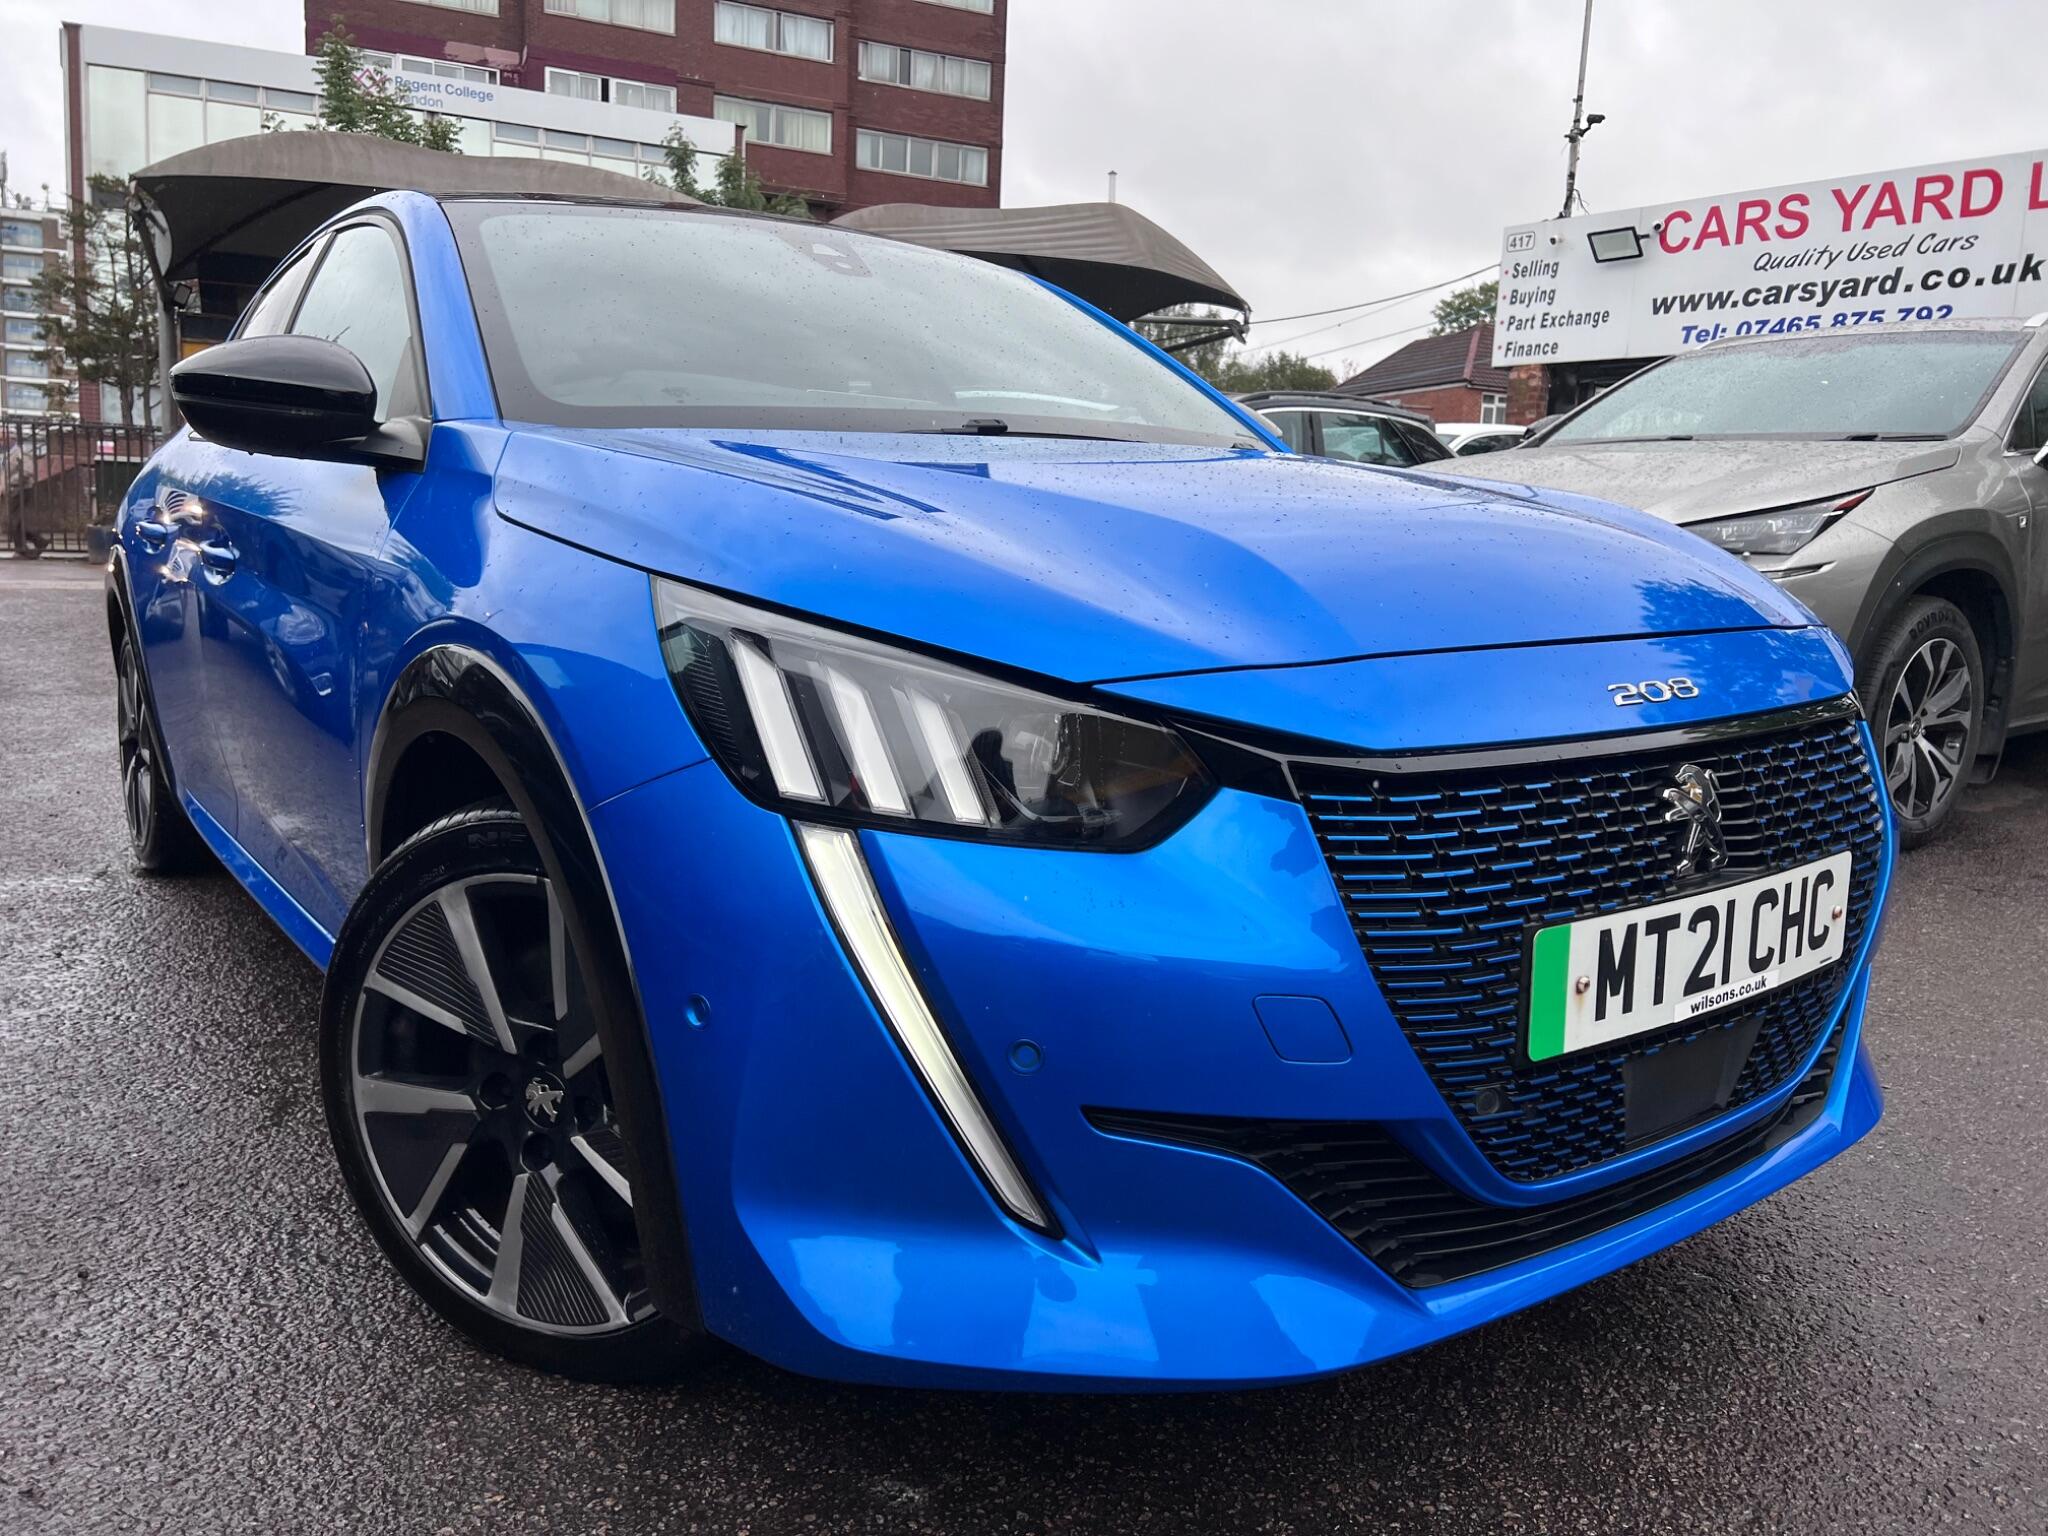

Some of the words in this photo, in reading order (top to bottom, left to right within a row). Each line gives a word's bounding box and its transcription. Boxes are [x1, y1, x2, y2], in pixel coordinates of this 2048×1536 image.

[394, 75, 441, 93] Regent
[445, 83, 494, 103] College
[395, 92, 444, 109] ondon
[1659, 193, 1810, 254] CARS
[1831, 167, 2003, 233] YARD
[1509, 234, 1532, 249] 417
[1753, 244, 1844, 271] Quality
[1847, 233, 1915, 262] Used
[1916, 232, 1979, 255] Cars
[1511, 259, 1560, 279] Selling
[1509, 286, 1557, 308] Buying
[1652, 252, 2047, 315] www.carsyard.co.uk
[1506, 312, 1536, 332] Part
[1540, 309, 1610, 329] Exchange
[1681, 322, 1727, 344] Tel:
[1735, 314, 1822, 336] 07465
[1830, 309, 1886, 327] 875
[1897, 304, 1953, 321] 792
[1504, 341, 1559, 358] Finance
[1607, 677, 1699, 706] 208
[1594, 898, 1736, 1023] MT21
[1748, 868, 1835, 974] CHC
[1690, 975, 1767, 1014] wilsons.co.uk
